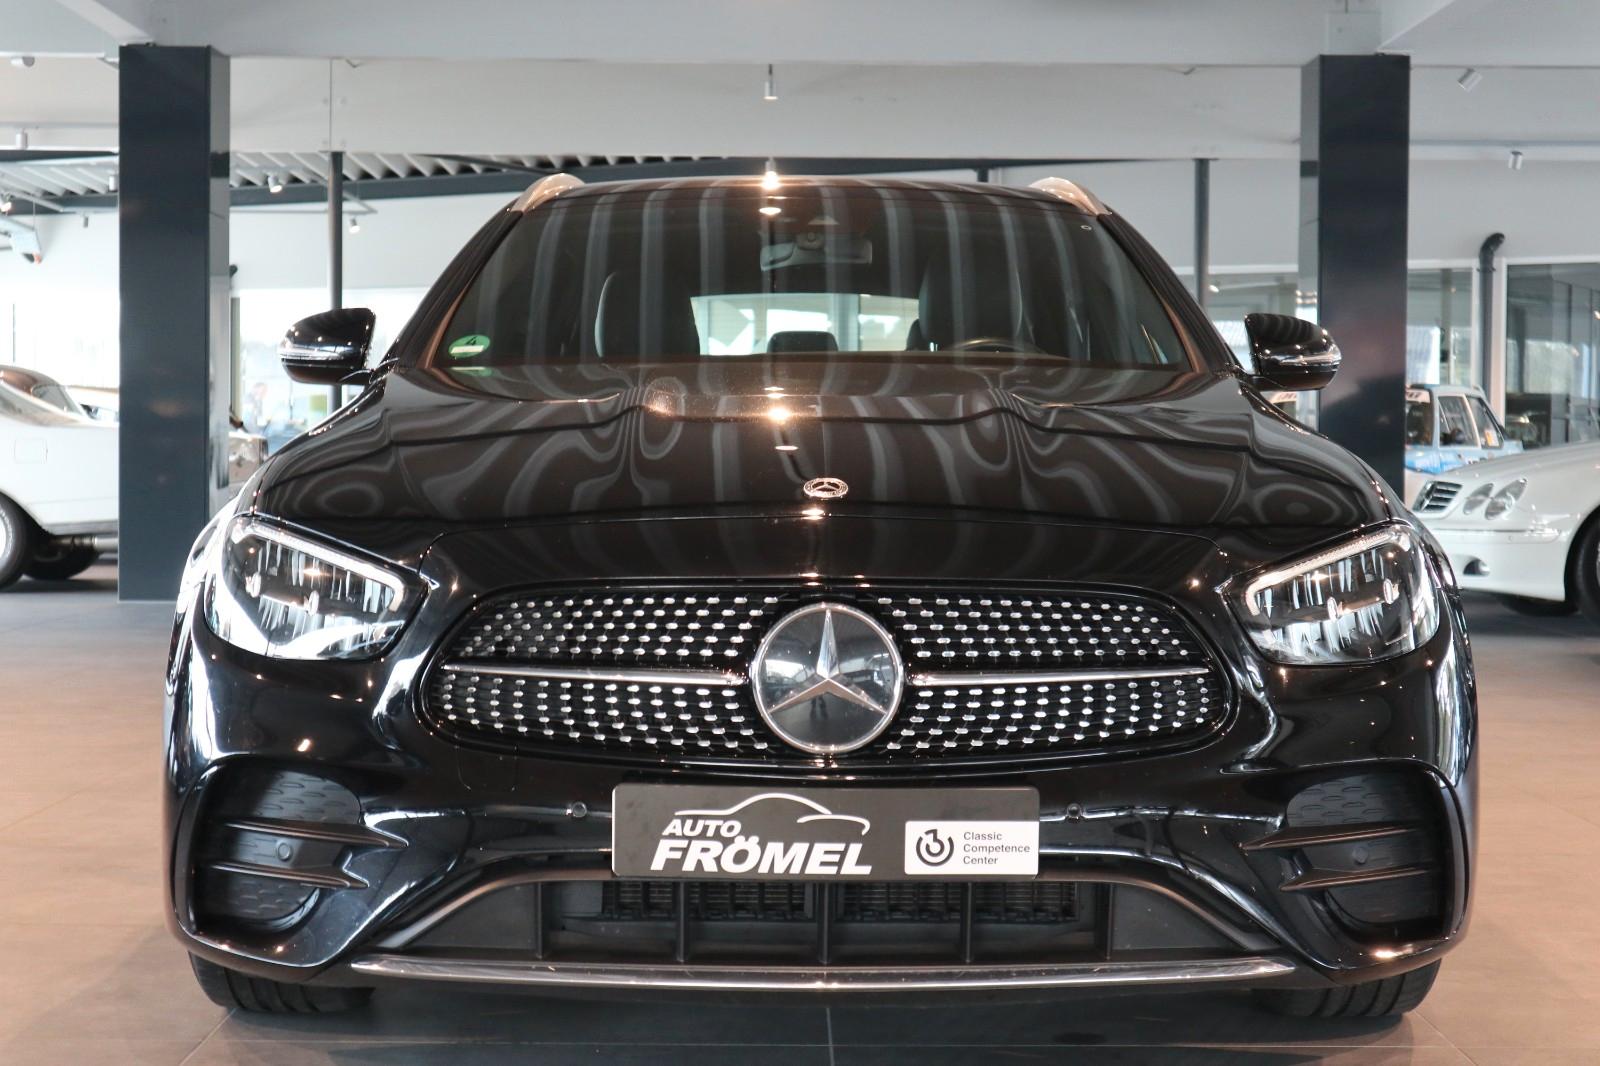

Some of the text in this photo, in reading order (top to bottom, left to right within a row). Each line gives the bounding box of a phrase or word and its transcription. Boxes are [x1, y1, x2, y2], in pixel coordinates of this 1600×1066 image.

[662, 819, 742, 837] AUTO
[963, 831, 1003, 841] Classic
[963, 843, 1031, 854] Competence
[650, 835, 872, 875] FRÖMEL
[963, 855, 998, 865] Center
